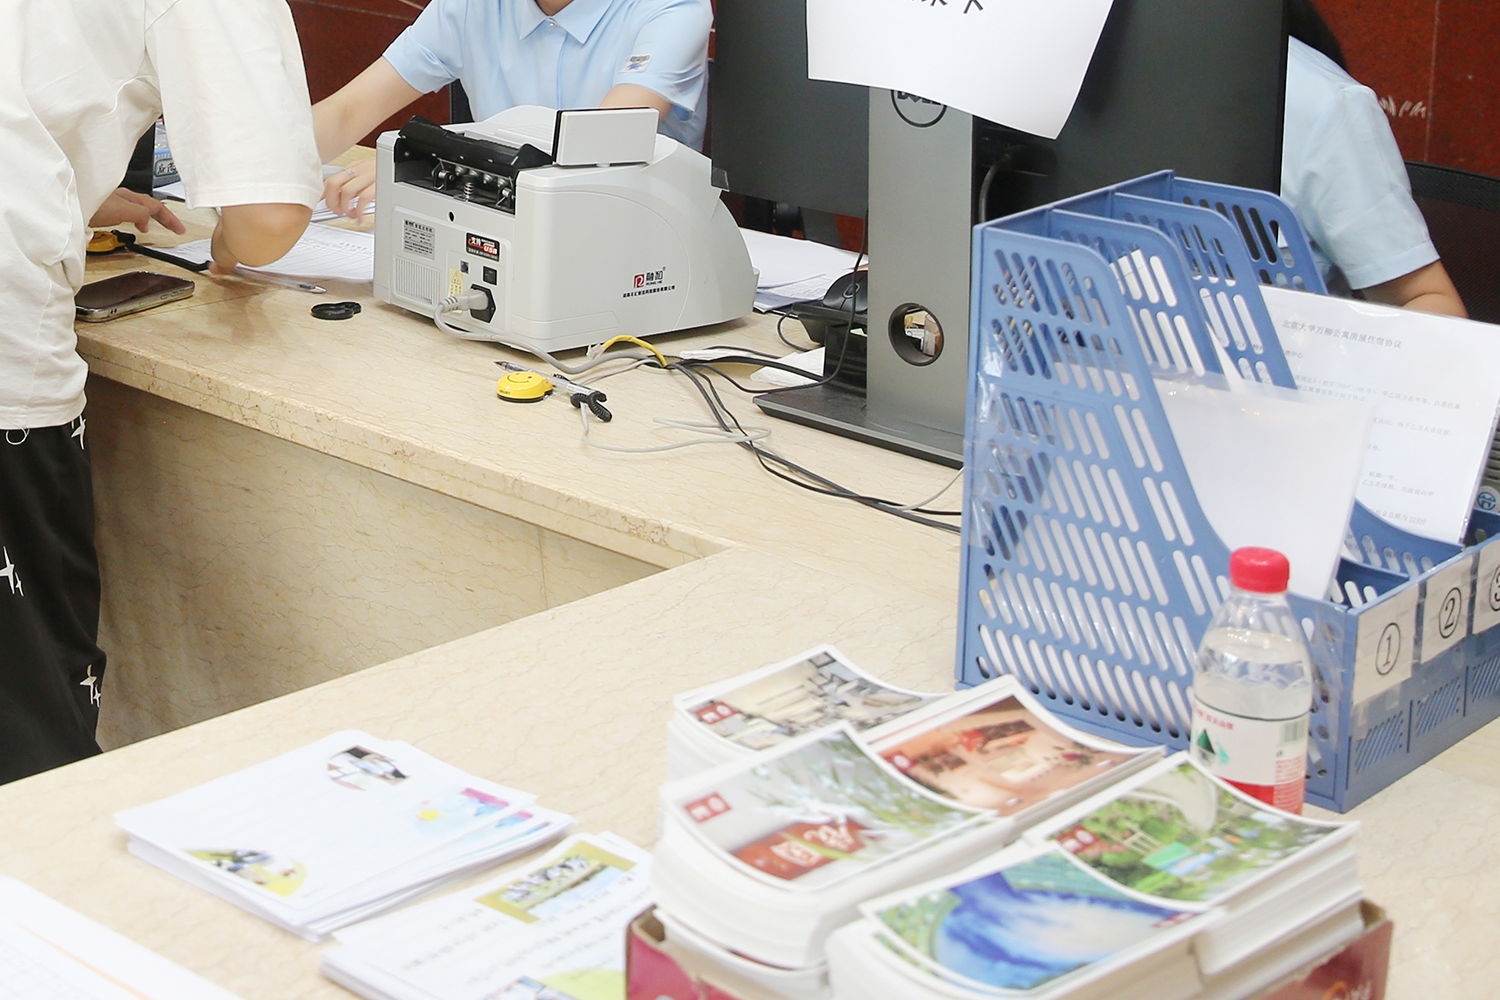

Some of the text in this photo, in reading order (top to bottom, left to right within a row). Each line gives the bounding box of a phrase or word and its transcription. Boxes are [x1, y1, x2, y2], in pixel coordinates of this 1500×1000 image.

[483, 245, 498, 255] USB
[1281, 319, 1402, 349] 北京大学万柳公寓房屋住宿协议
